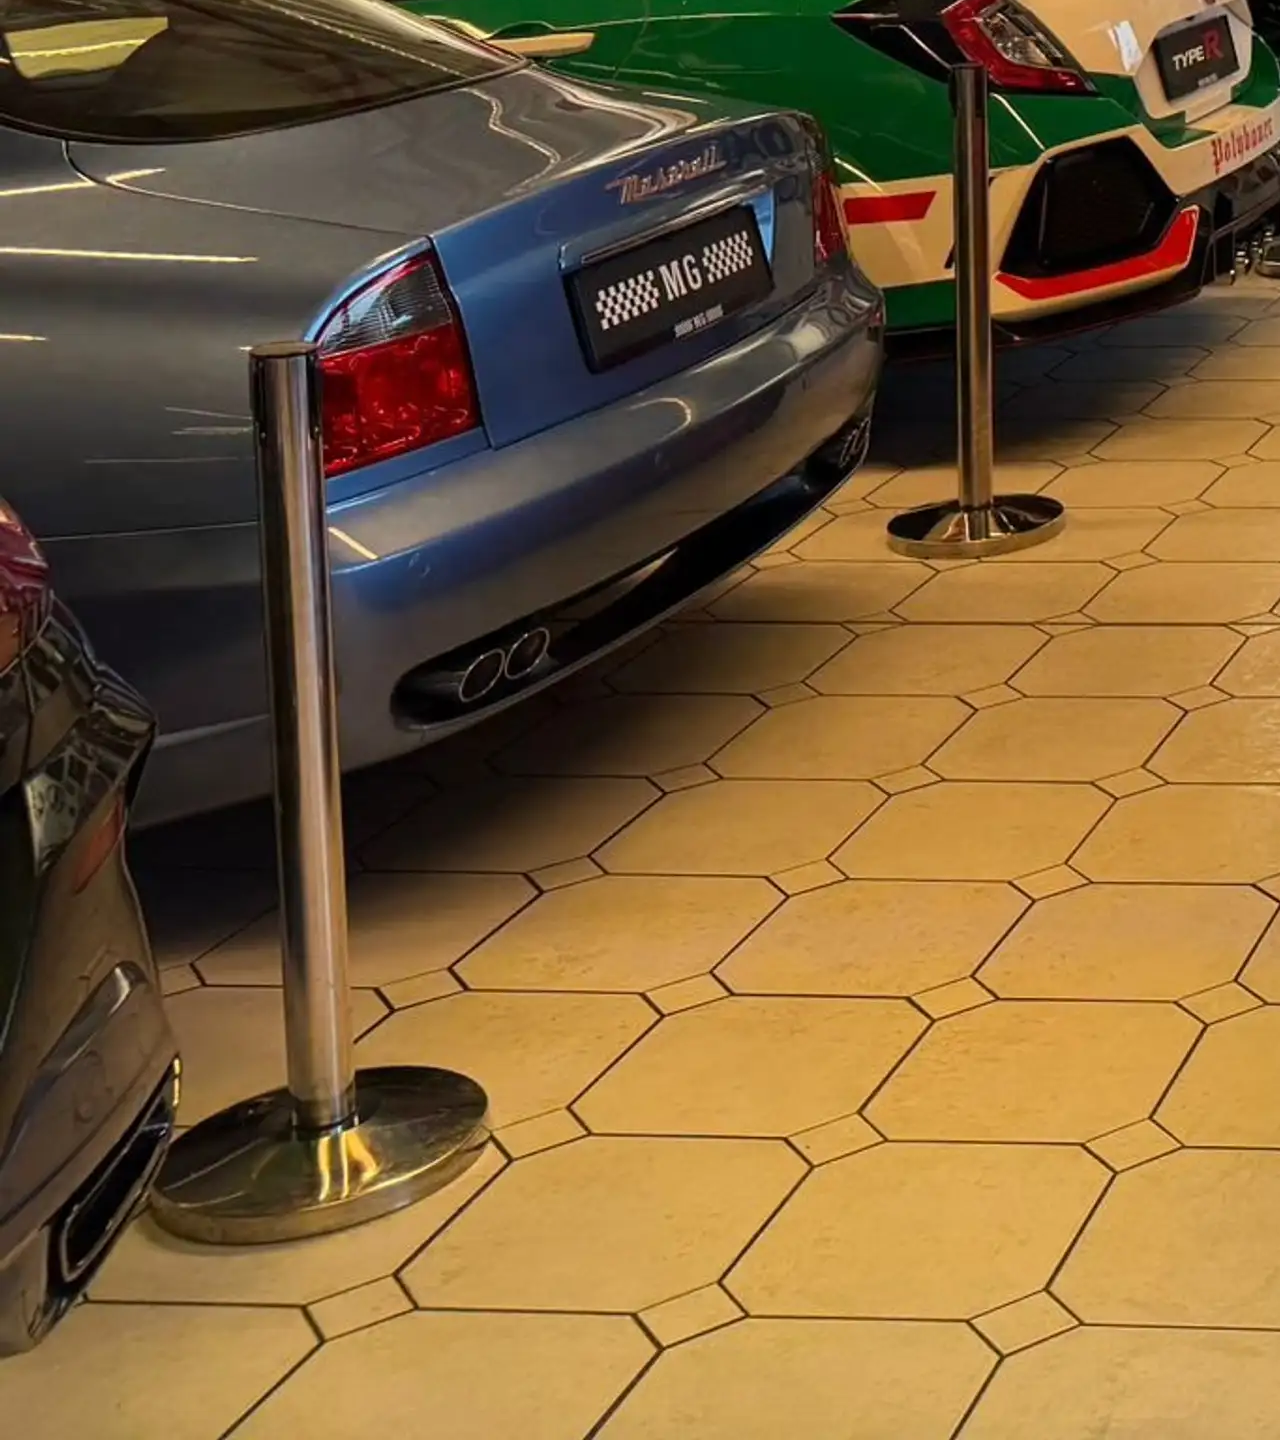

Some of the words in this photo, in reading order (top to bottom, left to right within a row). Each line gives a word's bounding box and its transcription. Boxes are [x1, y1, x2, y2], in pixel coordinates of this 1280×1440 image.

[1172, 44, 1205, 71] TYPE
[1203, 28, 1224, 60] R
[659, 254, 702, 301] MG
